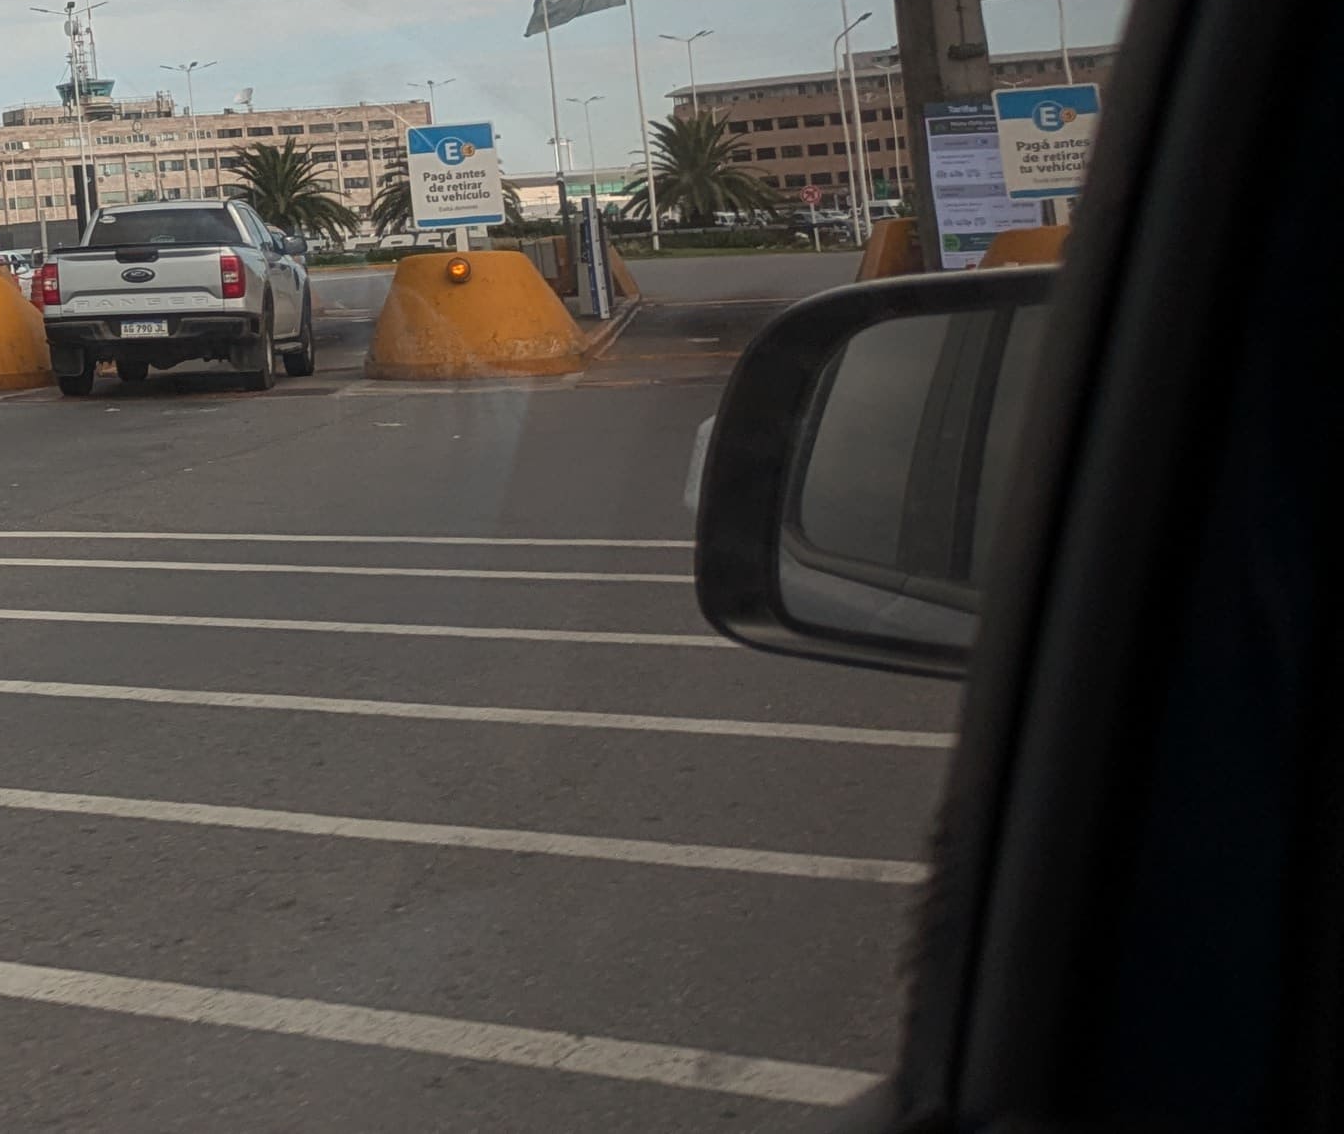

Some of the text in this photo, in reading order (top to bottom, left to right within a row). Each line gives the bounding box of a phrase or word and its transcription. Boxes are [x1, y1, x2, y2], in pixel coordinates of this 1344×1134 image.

[1040, 106, 1057, 127] E
[445, 142, 459, 160] E
[1016, 138, 1091, 152] Pagá antes
[1023, 151, 1086, 163] de retirar
[1020, 161, 1087, 174] tu vehícul
[423, 170, 486, 183] Pagá antes
[429, 181, 482, 192] de retirar
[426, 190, 490, 203] tu vehículo
[75, 296, 208, 307] RANGER
